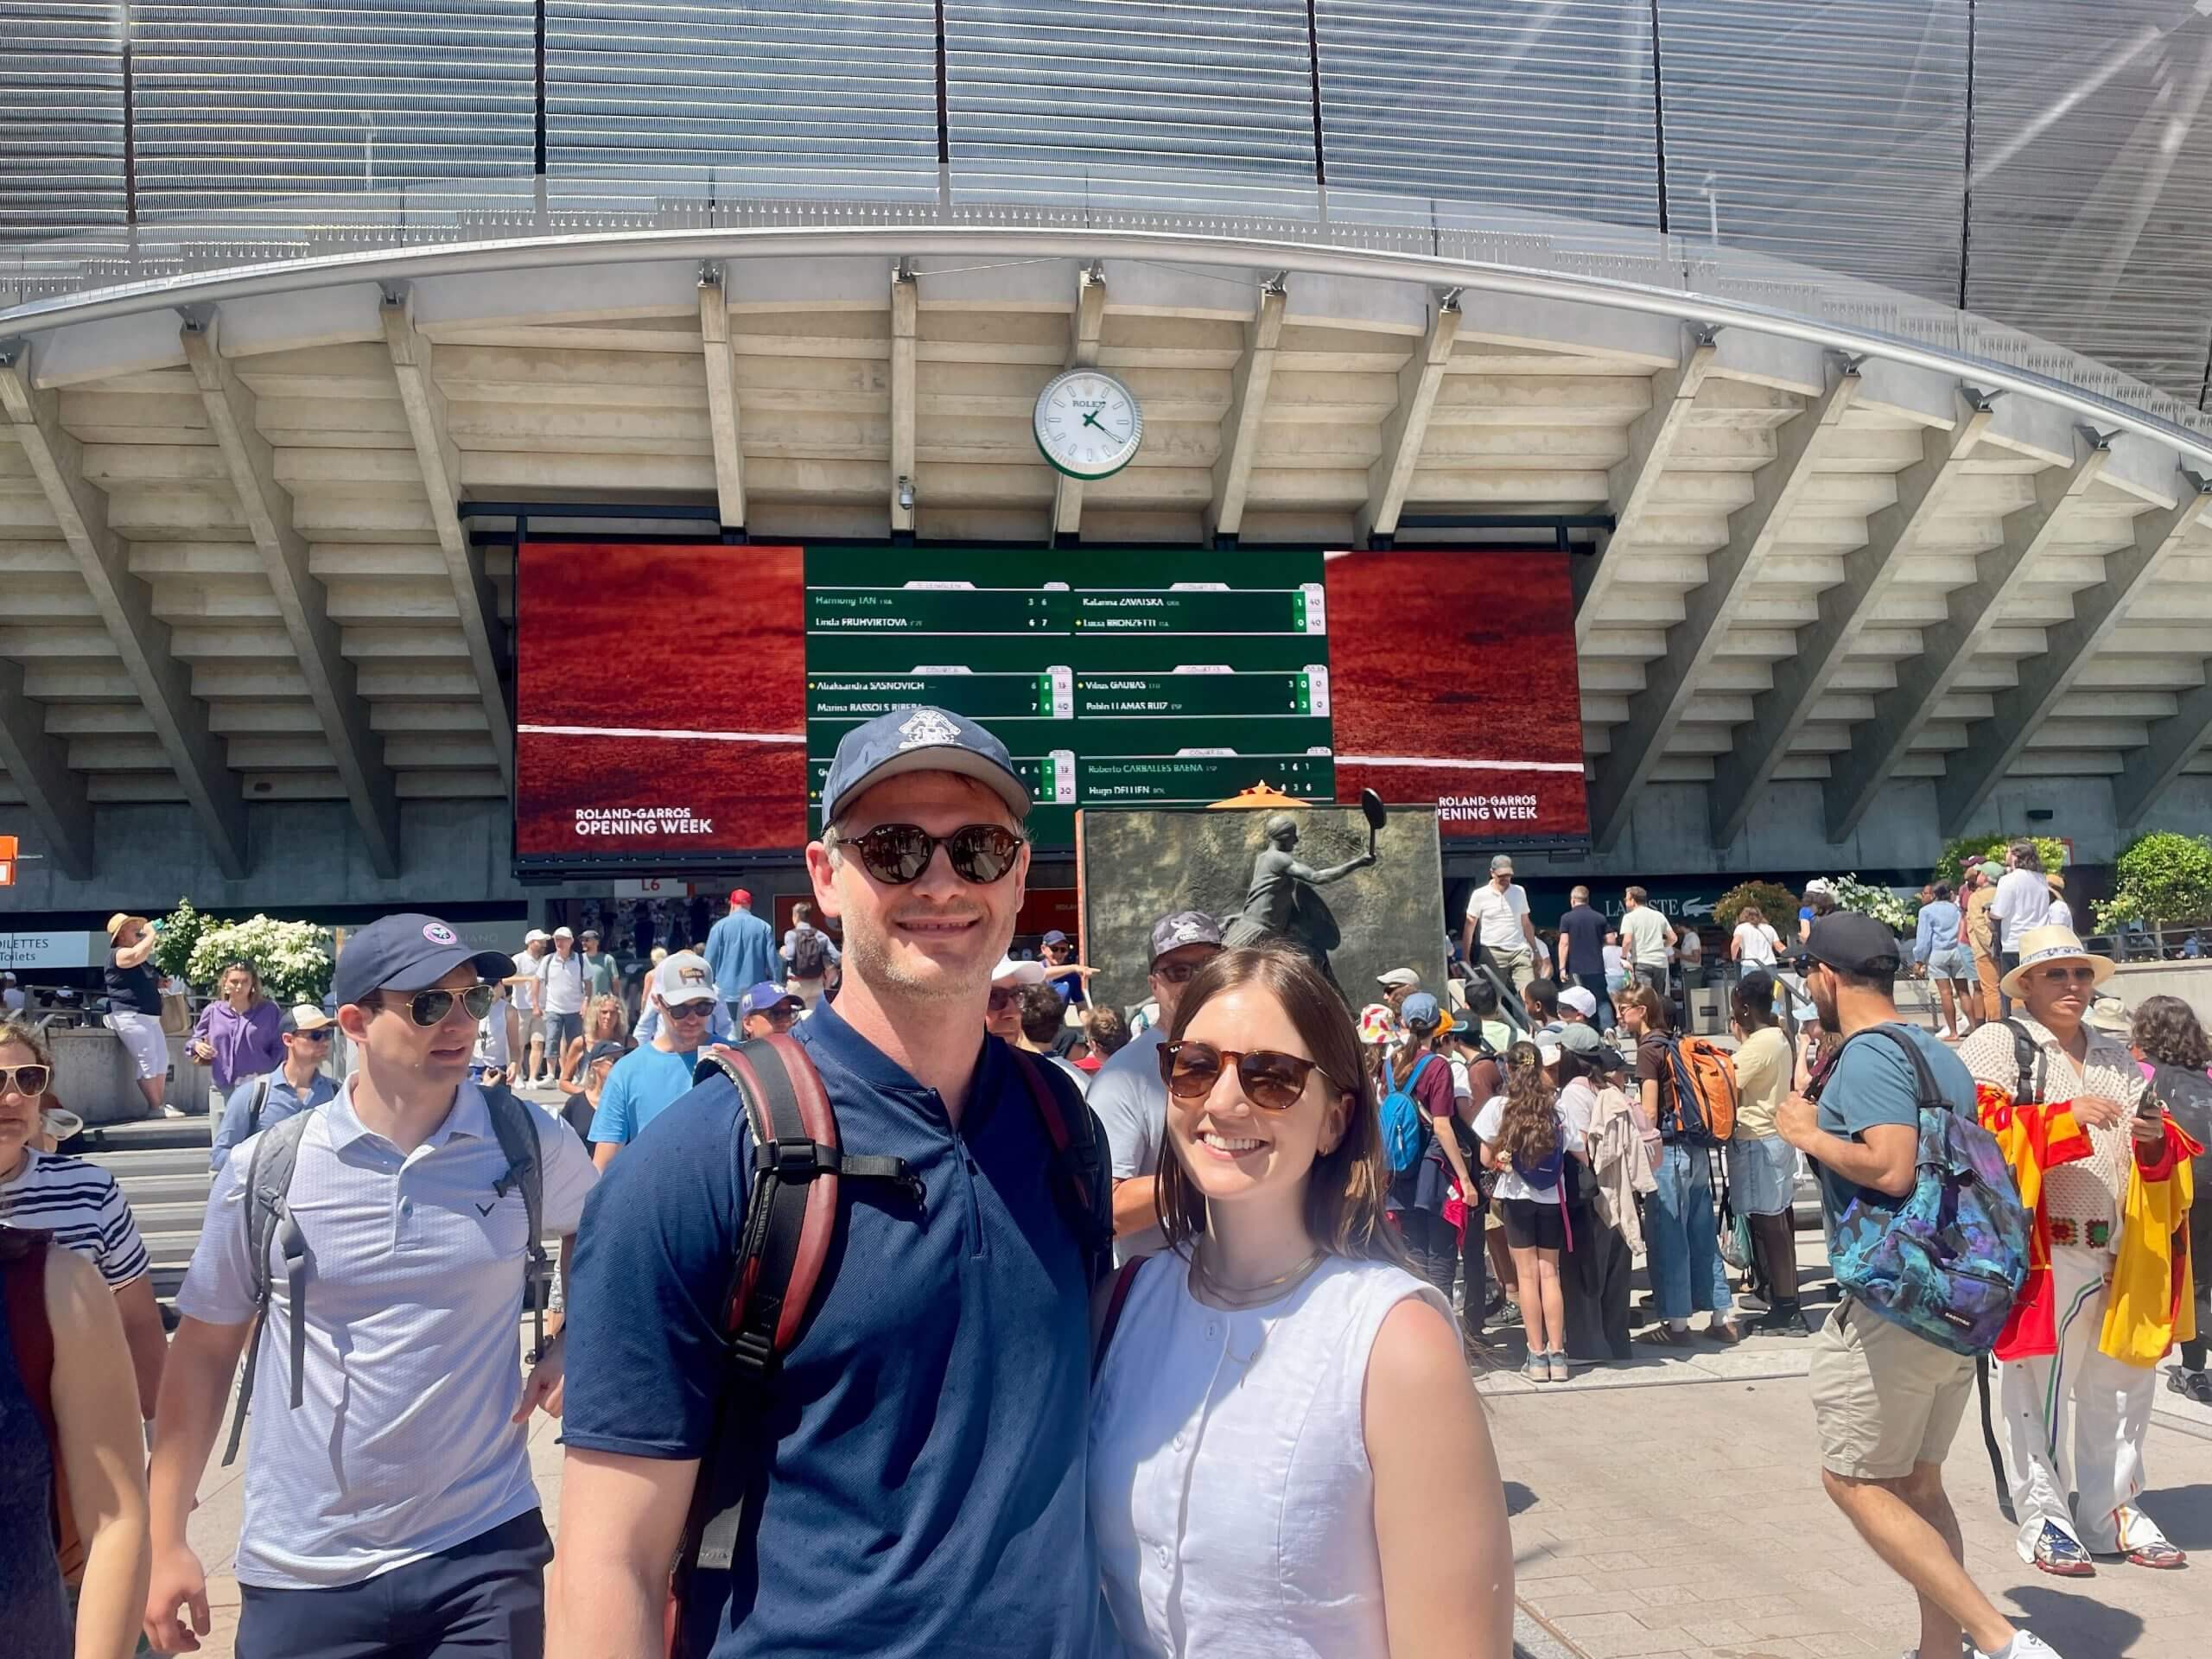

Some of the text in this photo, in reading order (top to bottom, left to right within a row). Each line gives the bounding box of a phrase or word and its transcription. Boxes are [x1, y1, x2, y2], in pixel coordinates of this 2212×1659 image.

[816, 596, 856, 607] Harmony
[1297, 598, 1302, 607] 1
[816, 618, 840, 626] Linda
[842, 618, 907, 626] FRUHVIRTOVA
[869, 682, 925, 690] SASNOVICH
[1123, 764, 1172, 773] CARBALLES
[1293, 762, 1299, 771] 6
[1439, 795, 1537, 807] ROLAND-GARROS
[575, 808, 691, 820] ROLAND-GARROS
[1438, 806, 1538, 821] ENING WEEK
[575, 818, 713, 836] OPENING WEEK
[641, 878, 660, 892] L6
[1605, 898, 1680, 918] LASTE
